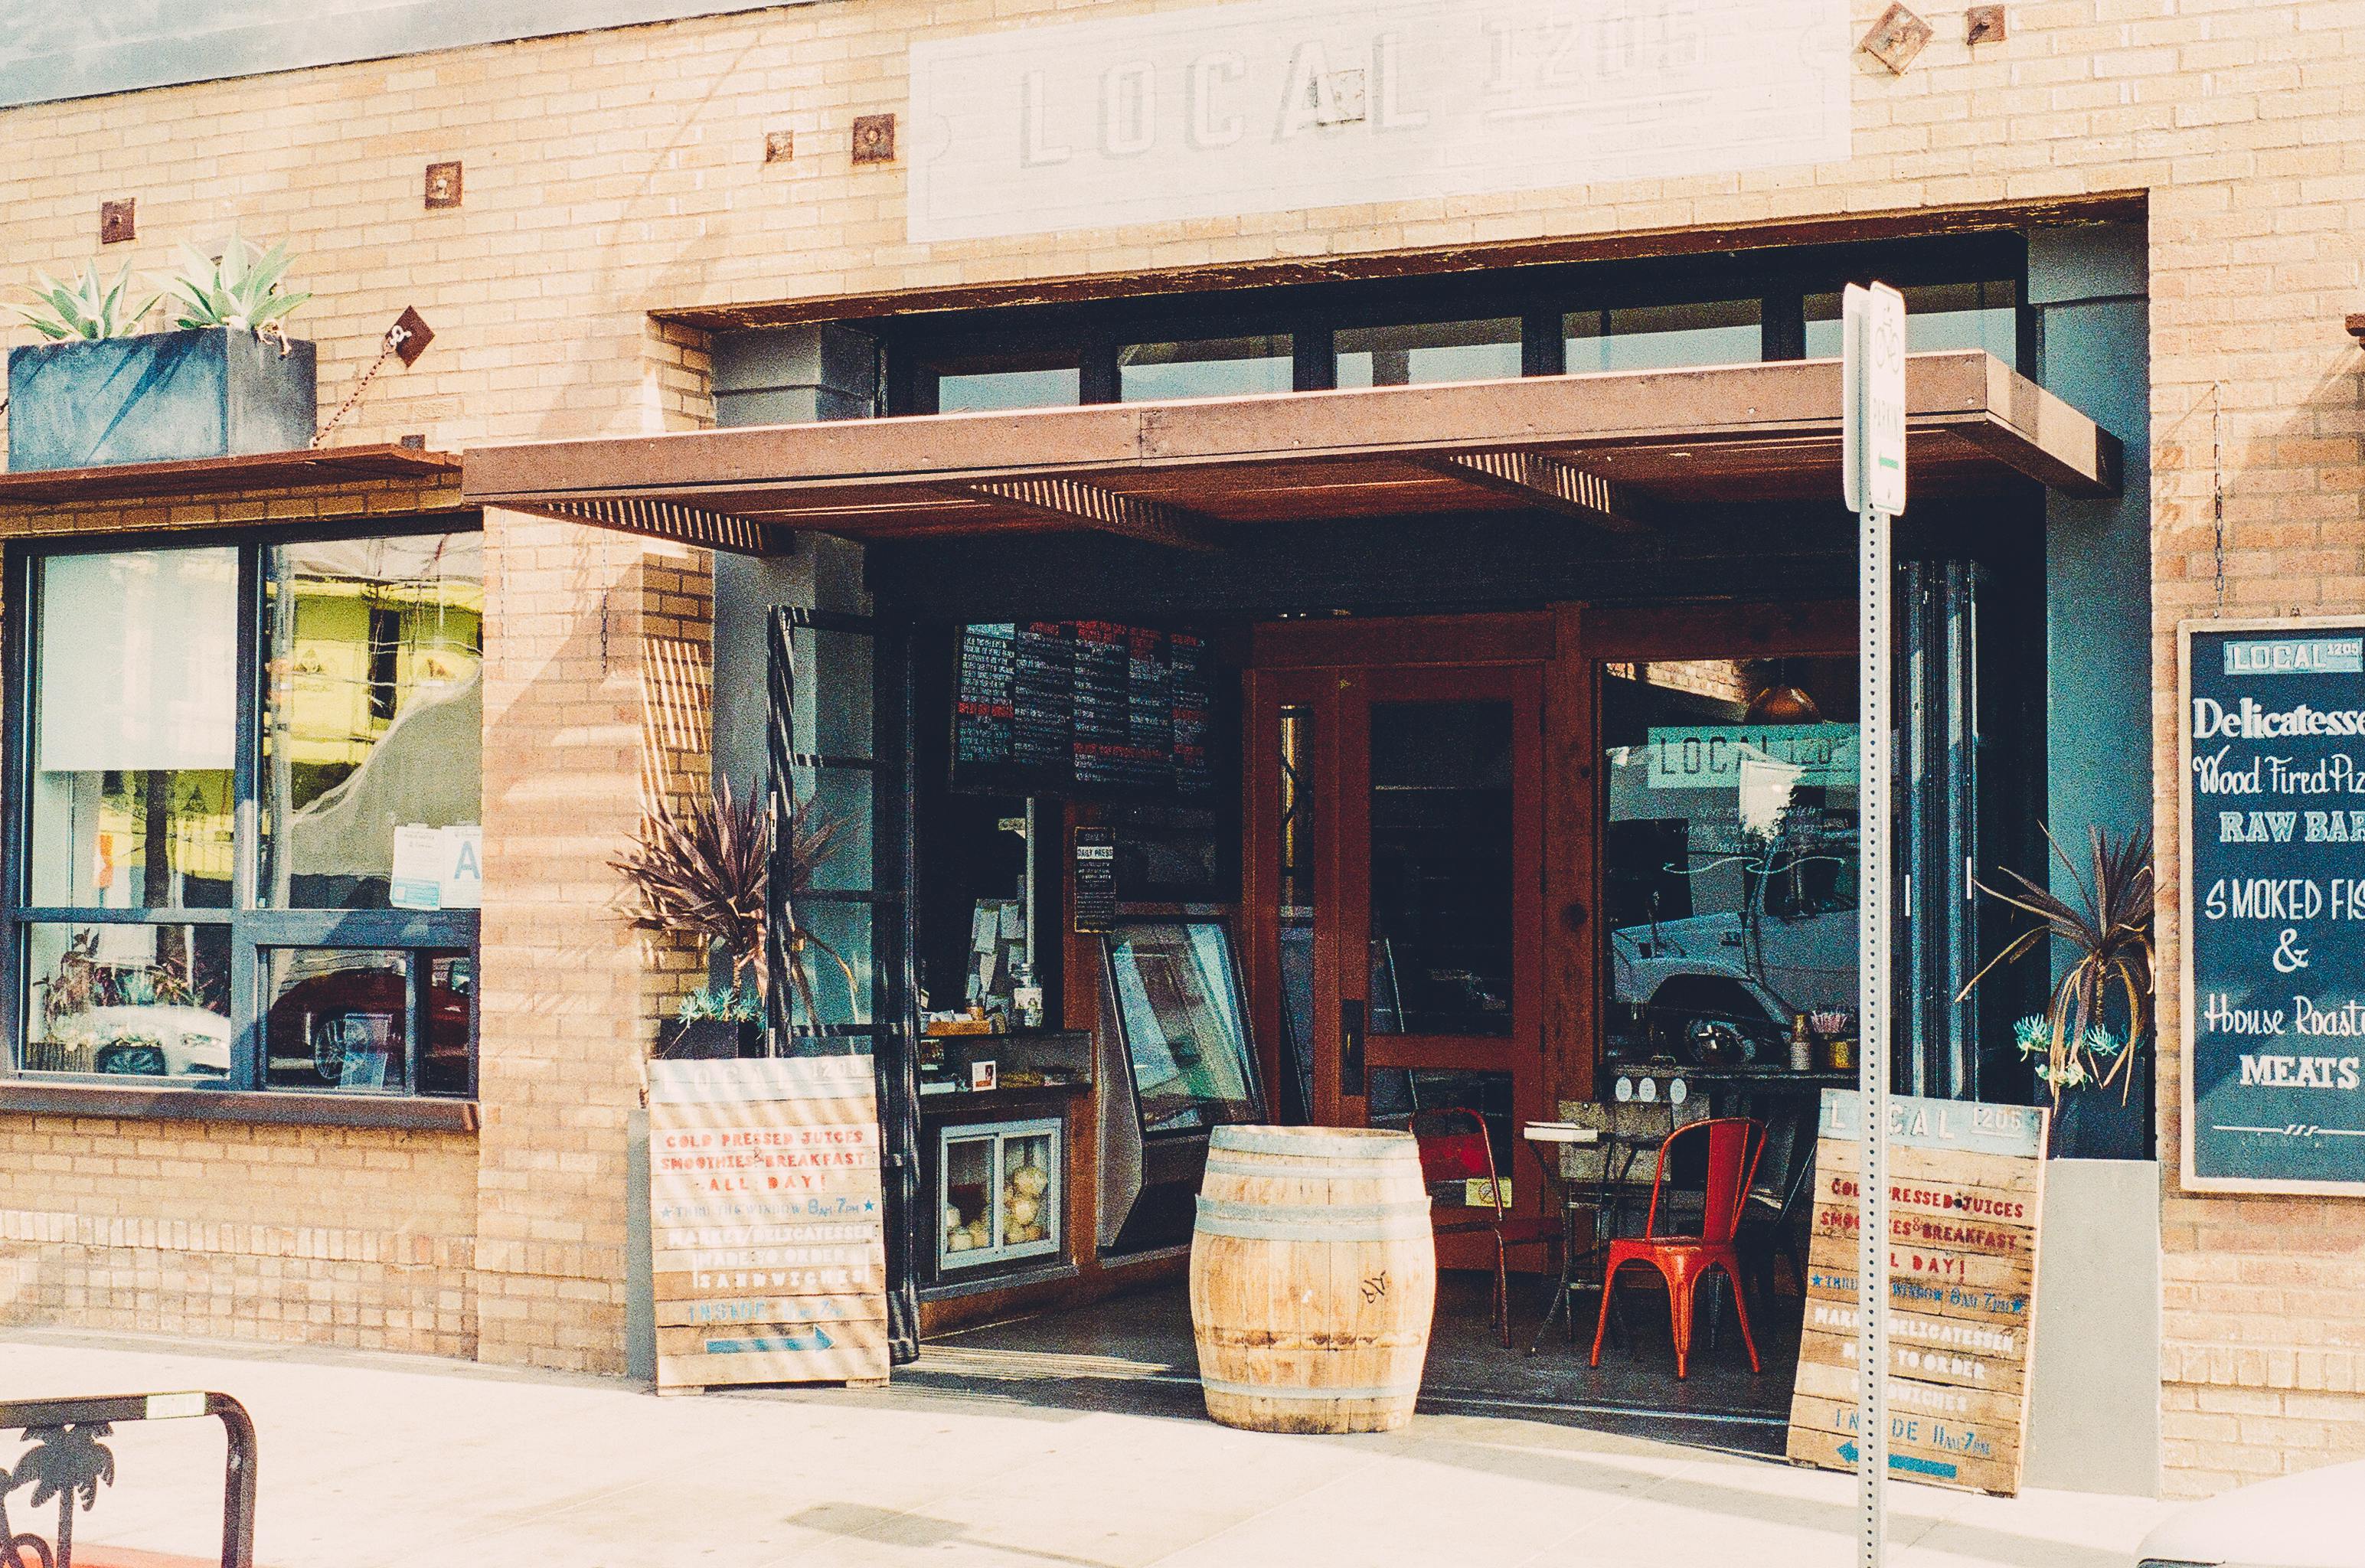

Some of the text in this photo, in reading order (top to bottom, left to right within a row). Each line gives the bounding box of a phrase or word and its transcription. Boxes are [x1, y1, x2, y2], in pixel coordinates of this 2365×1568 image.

[1021, 3, 1709, 168] LOCAL 1205
[2233, 642, 2359, 670] LOCAL 1205
[2193, 745, 2262, 794] Wood
[2265, 756, 2331, 794] Fired
[2219, 812, 2365, 843] RAW BAR
[454, 841, 481, 879] A
[2206, 879, 2321, 920] SMOKED
[2272, 928, 2308, 973] &
[2204, 994, 2285, 1036] House
[663, 1059, 864, 1094] LOCAL 1205
[2239, 1054, 2360, 1089] MEATS
[1831, 1099, 2022, 1139] LCAL 1205
[666, 1129, 864, 1148] COLD PRESSED JUICES
[661, 1154, 753, 1171] SMOOTHIES
[766, 1152, 865, 1169] BREAKFAST
[710, 1174, 826, 1192] ALL DAY!
[1831, 1181, 2024, 1218] COL RESSED JUICES
[1821, 1211, 1913, 1237] SMOOES
[1922, 1223, 2017, 1250] BREAKFAST
[698, 1249, 846, 1267] MADE TO ORDER
[1912, 1254, 1965, 1285] DAY!
[700, 1269, 864, 1289] SANDWICHES
[689, 1300, 766, 1323] INSIDE
[1898, 1349, 1986, 1379] TO ORDER
[1850, 1378, 1967, 1412] SDWICHES
[1835, 1409, 1919, 1441] INDE
